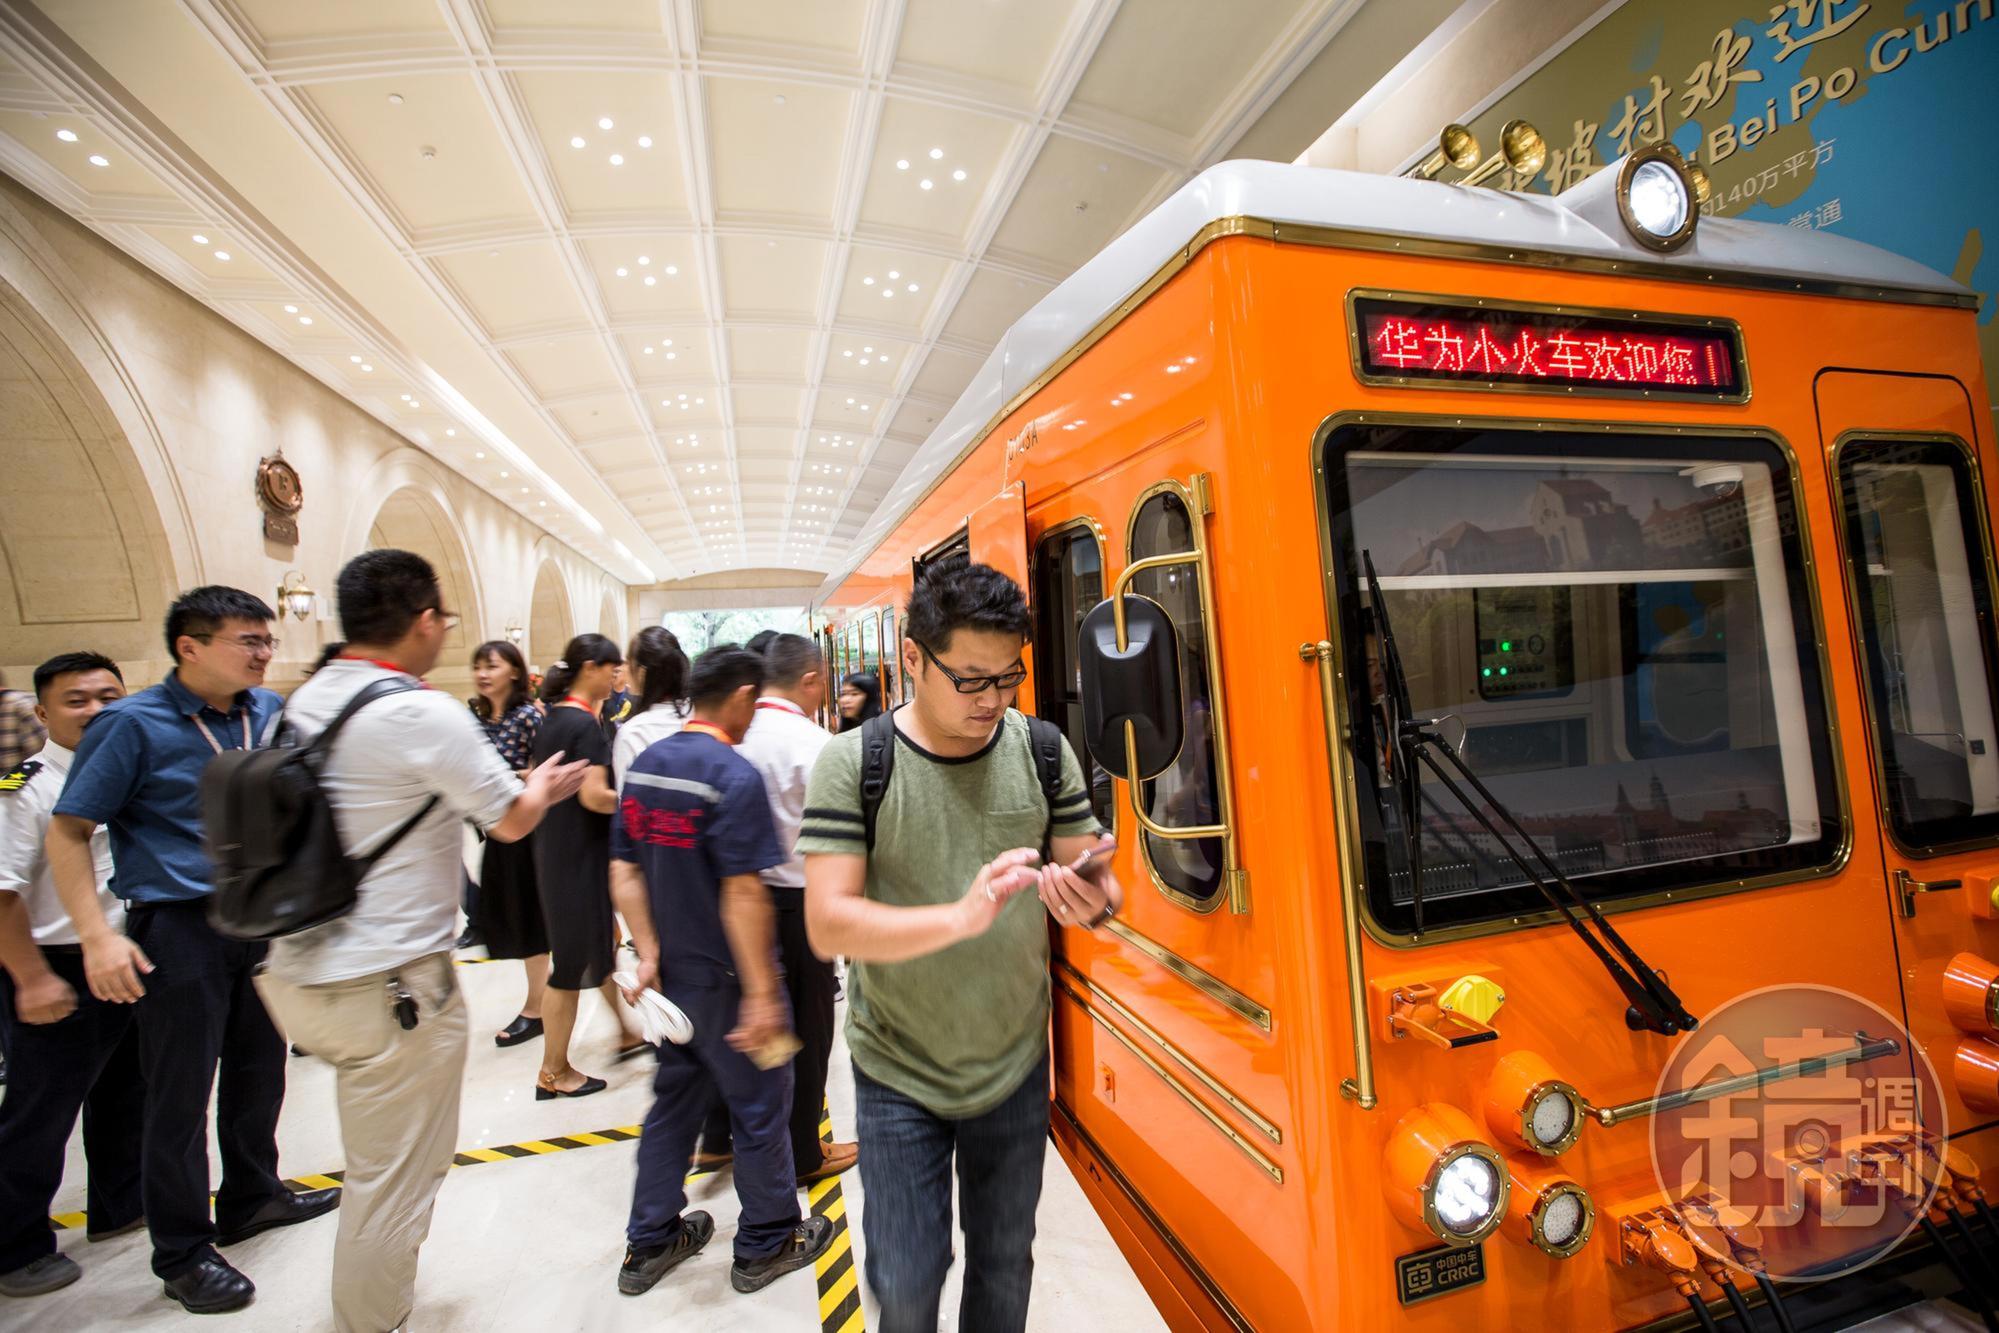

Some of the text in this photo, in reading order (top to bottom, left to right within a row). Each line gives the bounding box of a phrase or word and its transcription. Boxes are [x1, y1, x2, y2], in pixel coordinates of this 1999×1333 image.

[1708, 98, 1776, 165] Bei
[1790, 67, 1856, 121] Po
[1436, 1250, 1478, 1271] 中国中车
[1438, 1262, 1479, 1285] CRRC
